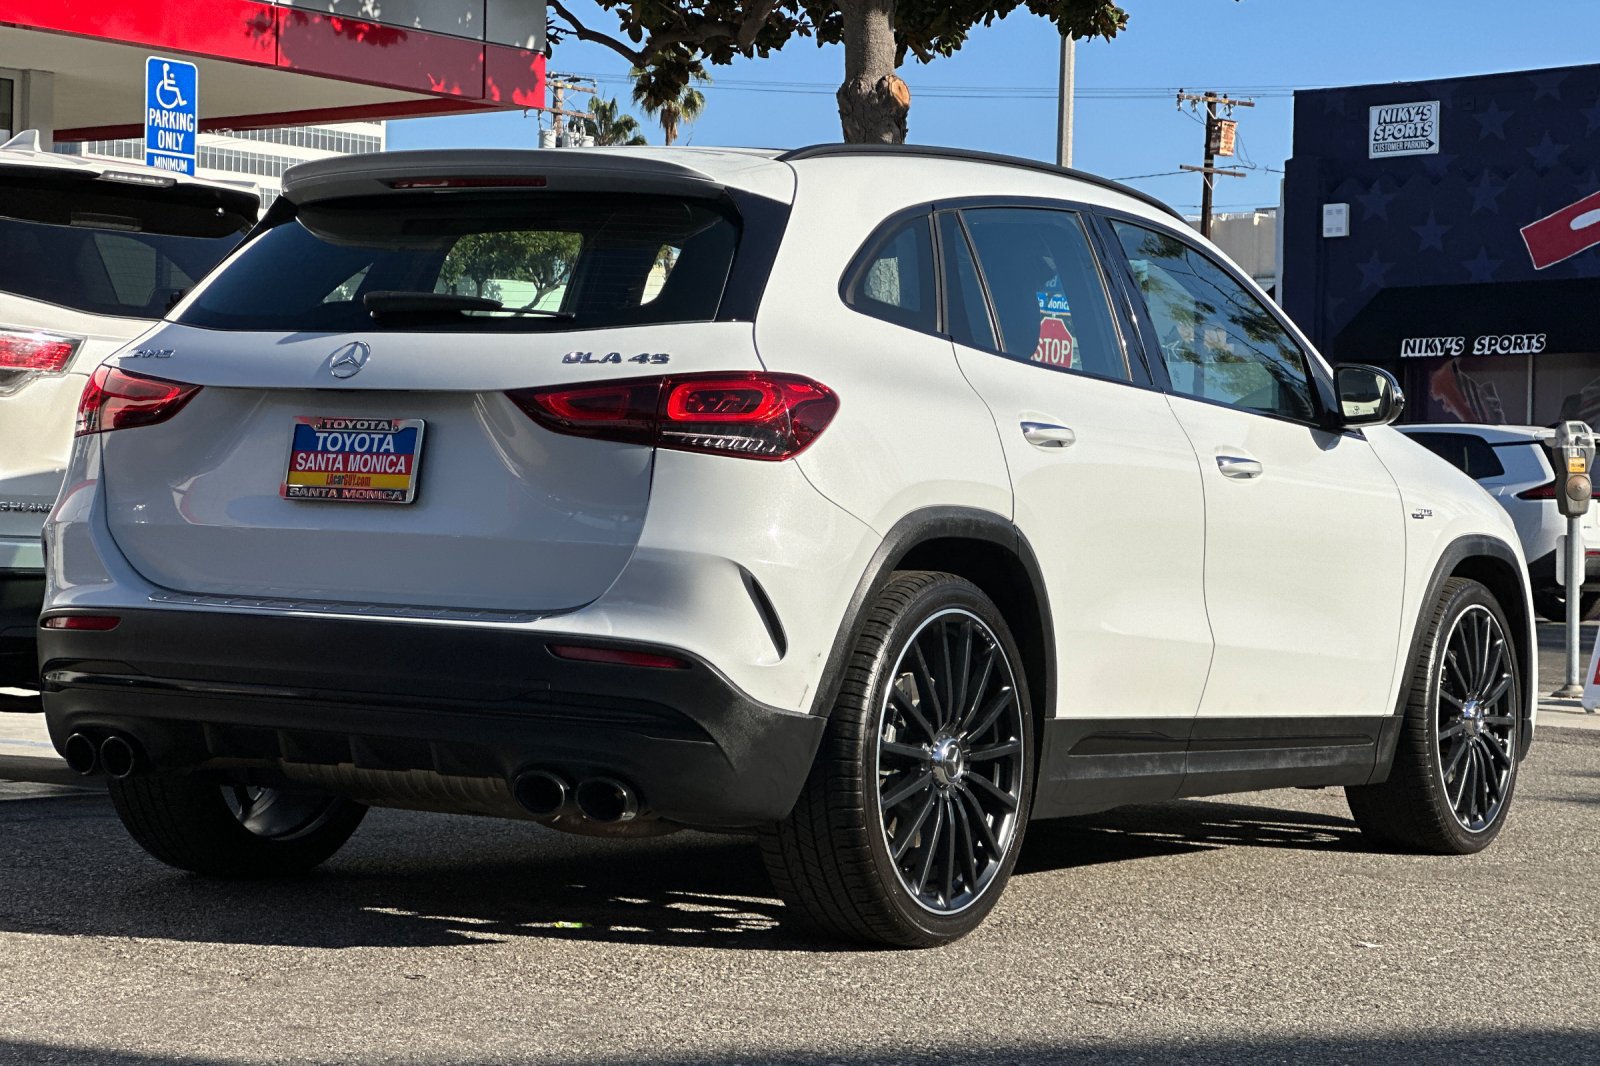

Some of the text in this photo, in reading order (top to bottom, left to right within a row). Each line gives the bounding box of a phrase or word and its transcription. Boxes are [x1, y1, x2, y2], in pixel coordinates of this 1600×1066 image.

[149, 107, 194, 132] PARKING
[1378, 105, 1432, 125] NIKY'S
[157, 129, 185, 151] ONLY
[1373, 121, 1433, 142] SPORTS
[1374, 139, 1430, 152] CUSTOMER PARKING
[153, 155, 188, 172] MINIMUM
[1034, 338, 1071, 364] STOP
[1400, 333, 1546, 357] NIKY'S SPORTS
[562, 352, 670, 364] GLA 45
[324, 419, 390, 431] TOYOTA
[315, 432, 395, 453] TOYOTA
[295, 452, 406, 473] SANTA MONICA
[289, 487, 402, 500] SANTA MONICA
